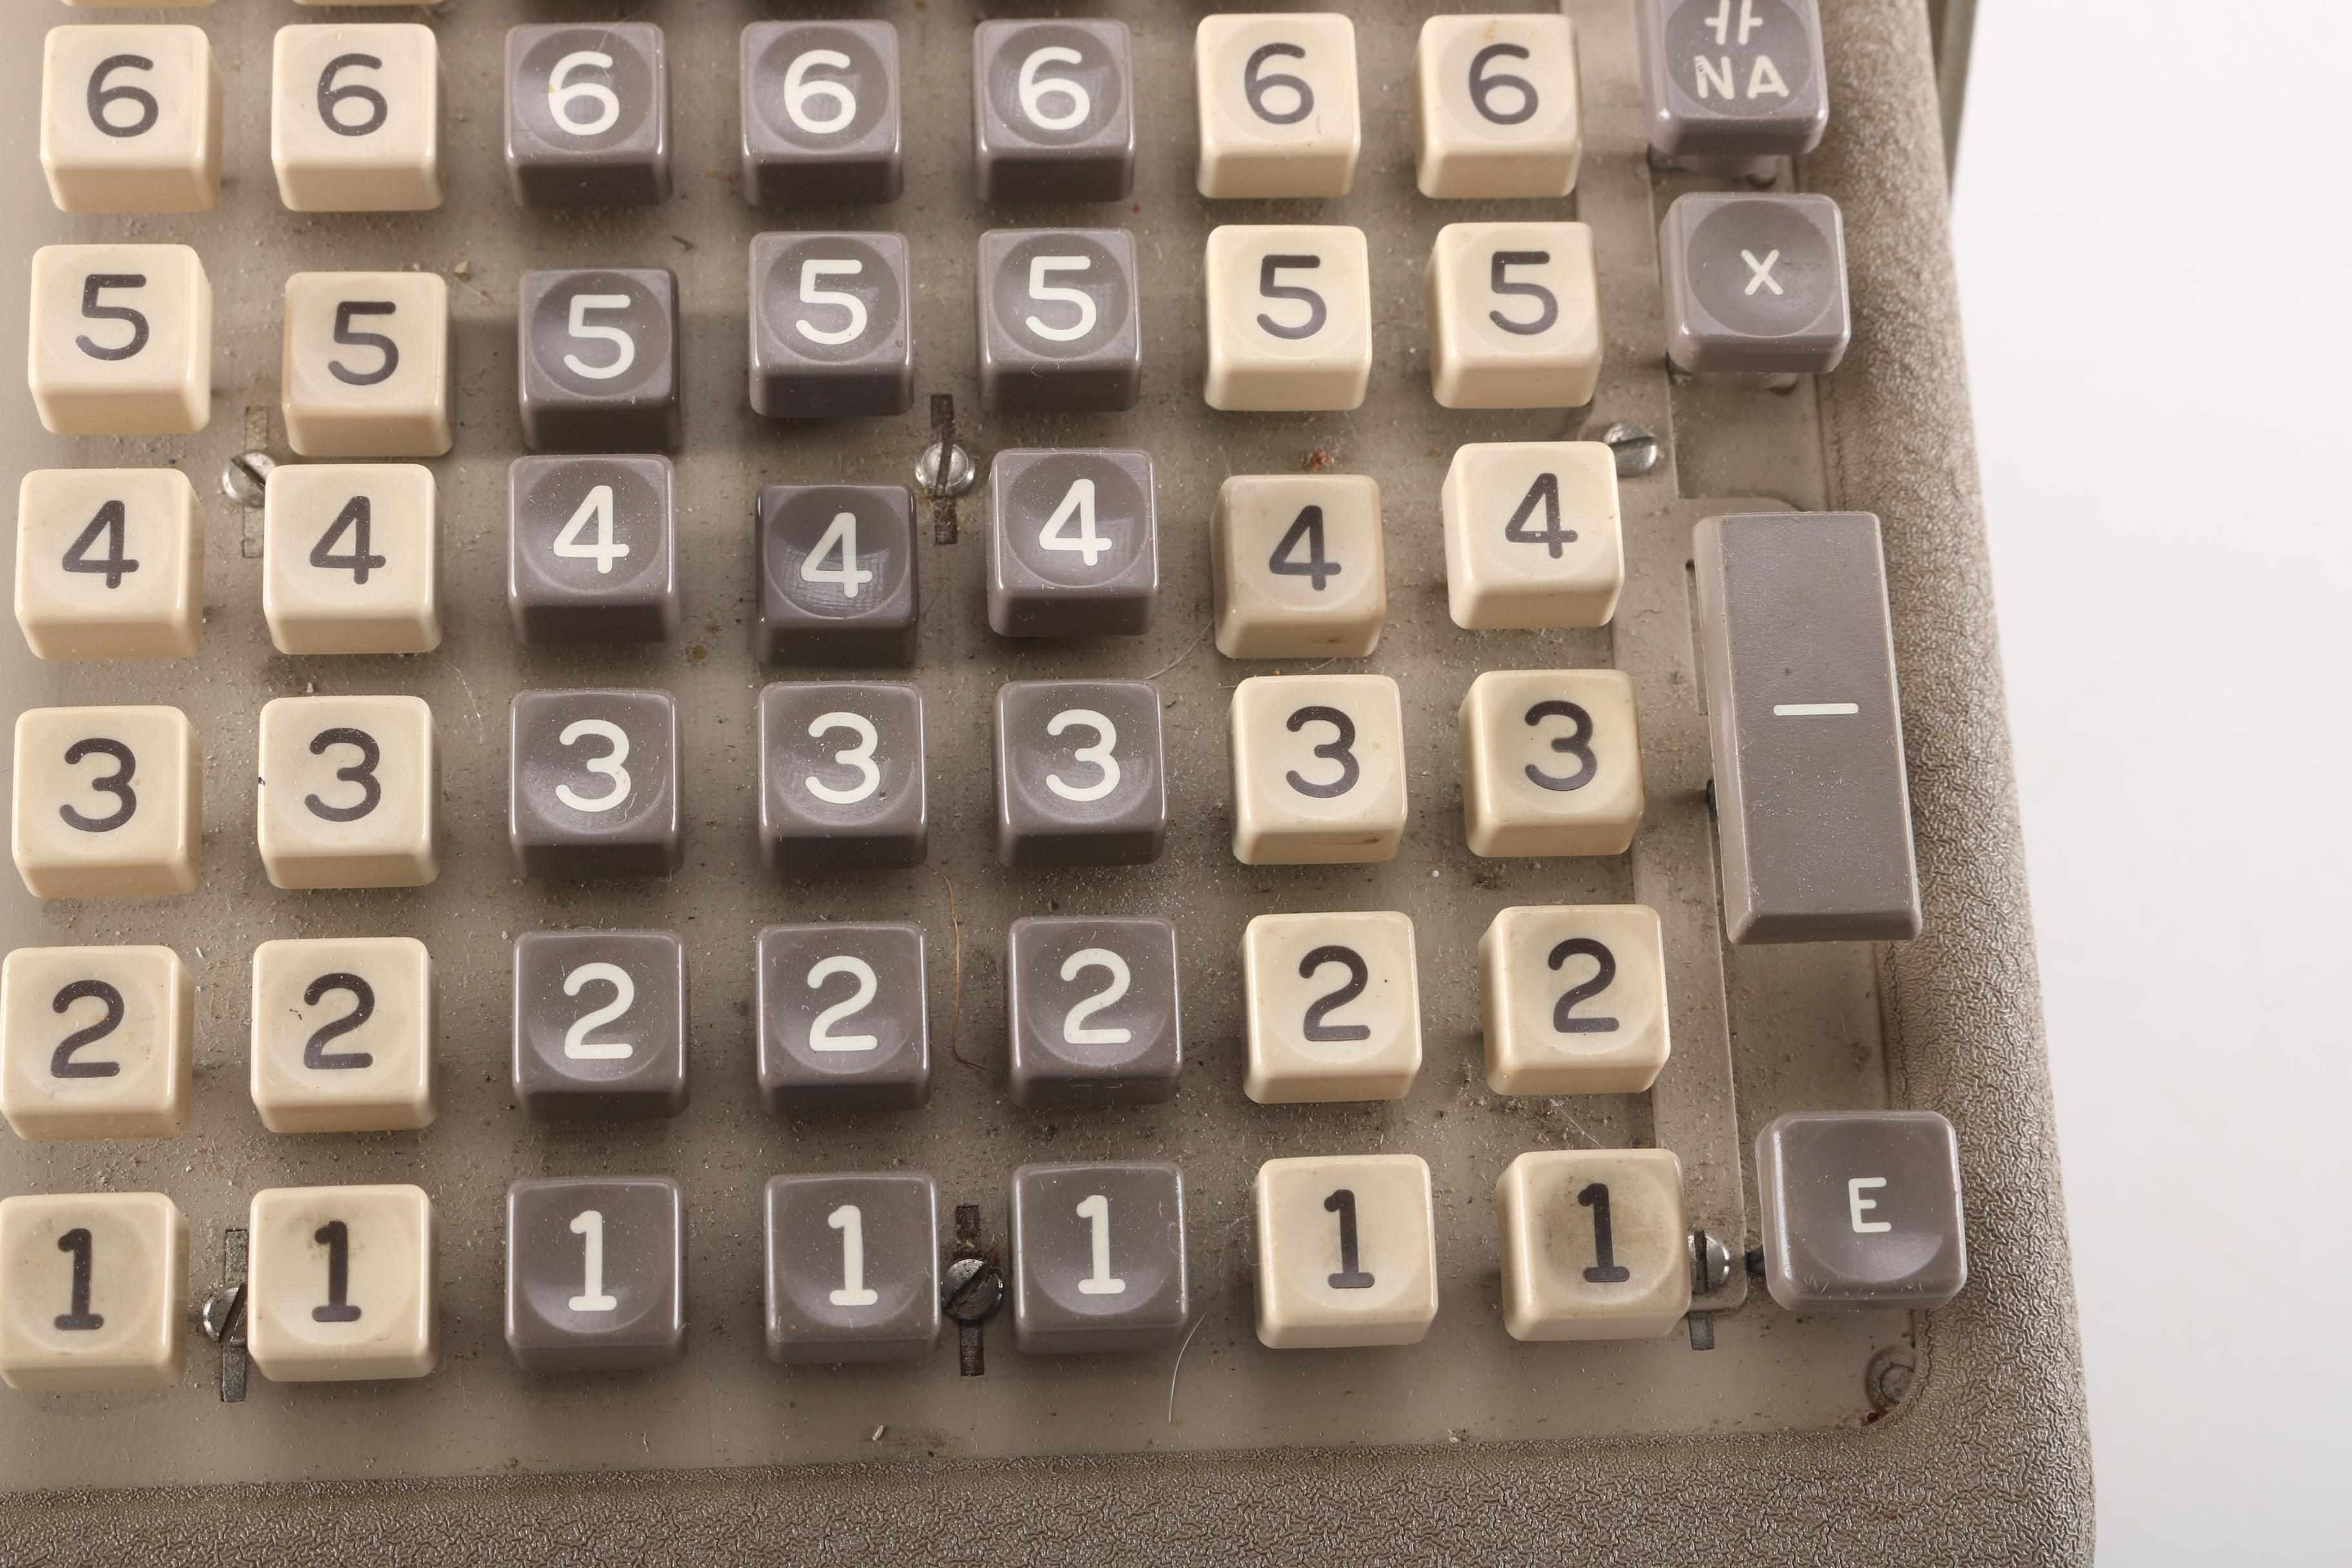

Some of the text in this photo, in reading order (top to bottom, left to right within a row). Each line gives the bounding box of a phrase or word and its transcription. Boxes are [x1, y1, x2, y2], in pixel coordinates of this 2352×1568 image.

[87, 54, 158, 137] 6
[317, 54, 387, 136] 6
[547, 51, 620, 135] 6
[783, 50, 856, 133] 6
[1019, 47, 1090, 130] 6
[1244, 43, 1313, 124] 6
[1469, 43, 1538, 124] 6
[1694, 55, 1789, 99] NA
[76, 274, 149, 360] 5
[564, 295, 634, 379] 5
[796, 260, 867, 345] 5
[1026, 256, 1097, 341] 5
[1257, 254, 1326, 339] 5
[1489, 251, 1558, 335] 5
[328, 301, 398, 386] 5
[63, 500, 139, 589] 4
[310, 496, 386, 584] 4
[553, 485, 629, 573] 4
[801, 513, 876, 602] 4
[1039, 479, 1112, 566] 4
[1269, 505, 1341, 590] 4
[1505, 473, 1578, 558] 4
[60, 738, 137, 832] 3
[305, 728, 381, 822] 3
[555, 720, 631, 812] 3
[805, 712, 880, 804] 3
[1046, 710, 1120, 802] 3
[1286, 706, 1359, 798] 3
[1524, 700, 1596, 791] 3
[51, 979, 124, 1078] 2
[304, 972, 375, 1069] 2
[564, 963, 634, 1060] 2
[808, 956, 877, 1052] 2
[1061, 948, 1132, 1044] 2
[1298, 945, 1370, 1041] 2
[1547, 937, 1619, 1033] 2
[1077, 1195, 1126, 1295] 1
[1324, 1189, 1375, 1289] 1
[1577, 1183, 1629, 1282] 1
[1848, 1177, 1891, 1233] E
[55, 1228, 104, 1330] 1
[313, 1220, 361, 1322] 1
[569, 1211, 617, 1311] 1
[828, 1206, 878, 1306] 1
